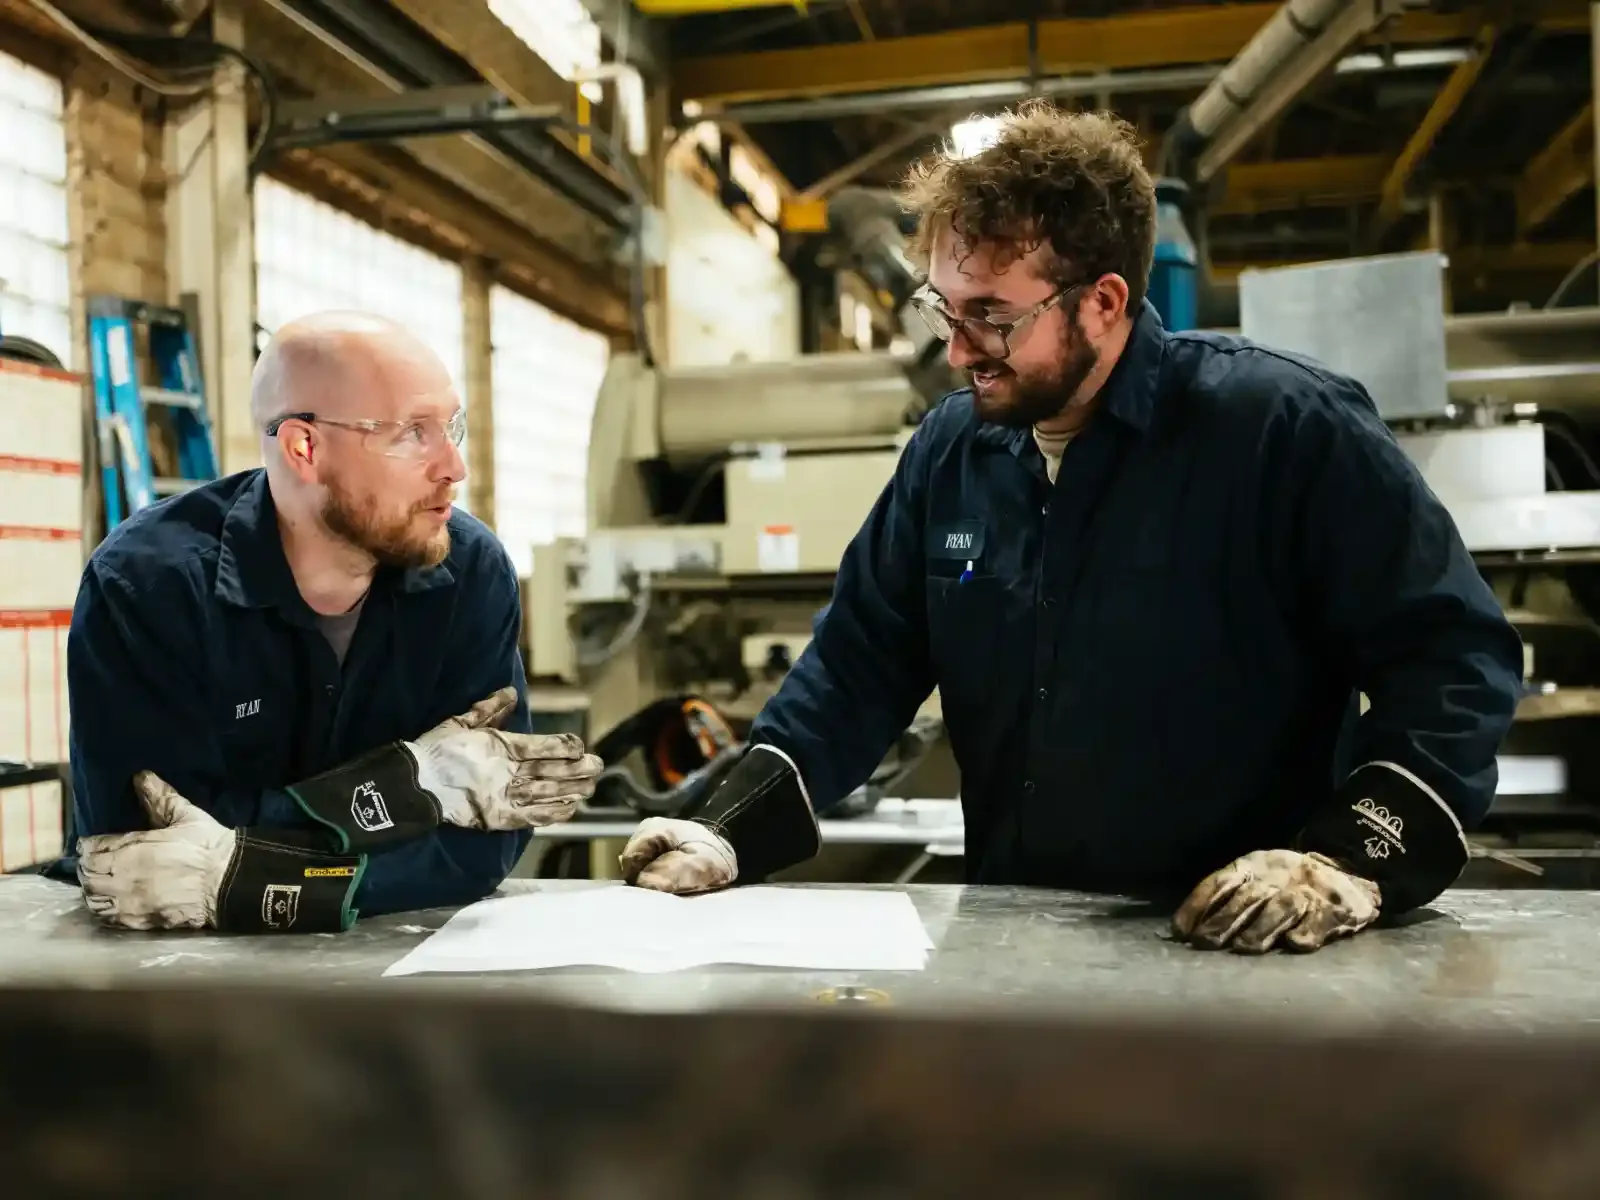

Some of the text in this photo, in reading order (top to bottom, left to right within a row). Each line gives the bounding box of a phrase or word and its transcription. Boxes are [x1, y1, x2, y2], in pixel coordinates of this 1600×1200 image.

[945, 533, 973, 549] RYAN
[235, 698, 262, 720] RYAN
[309, 867, 346, 876] Endura
